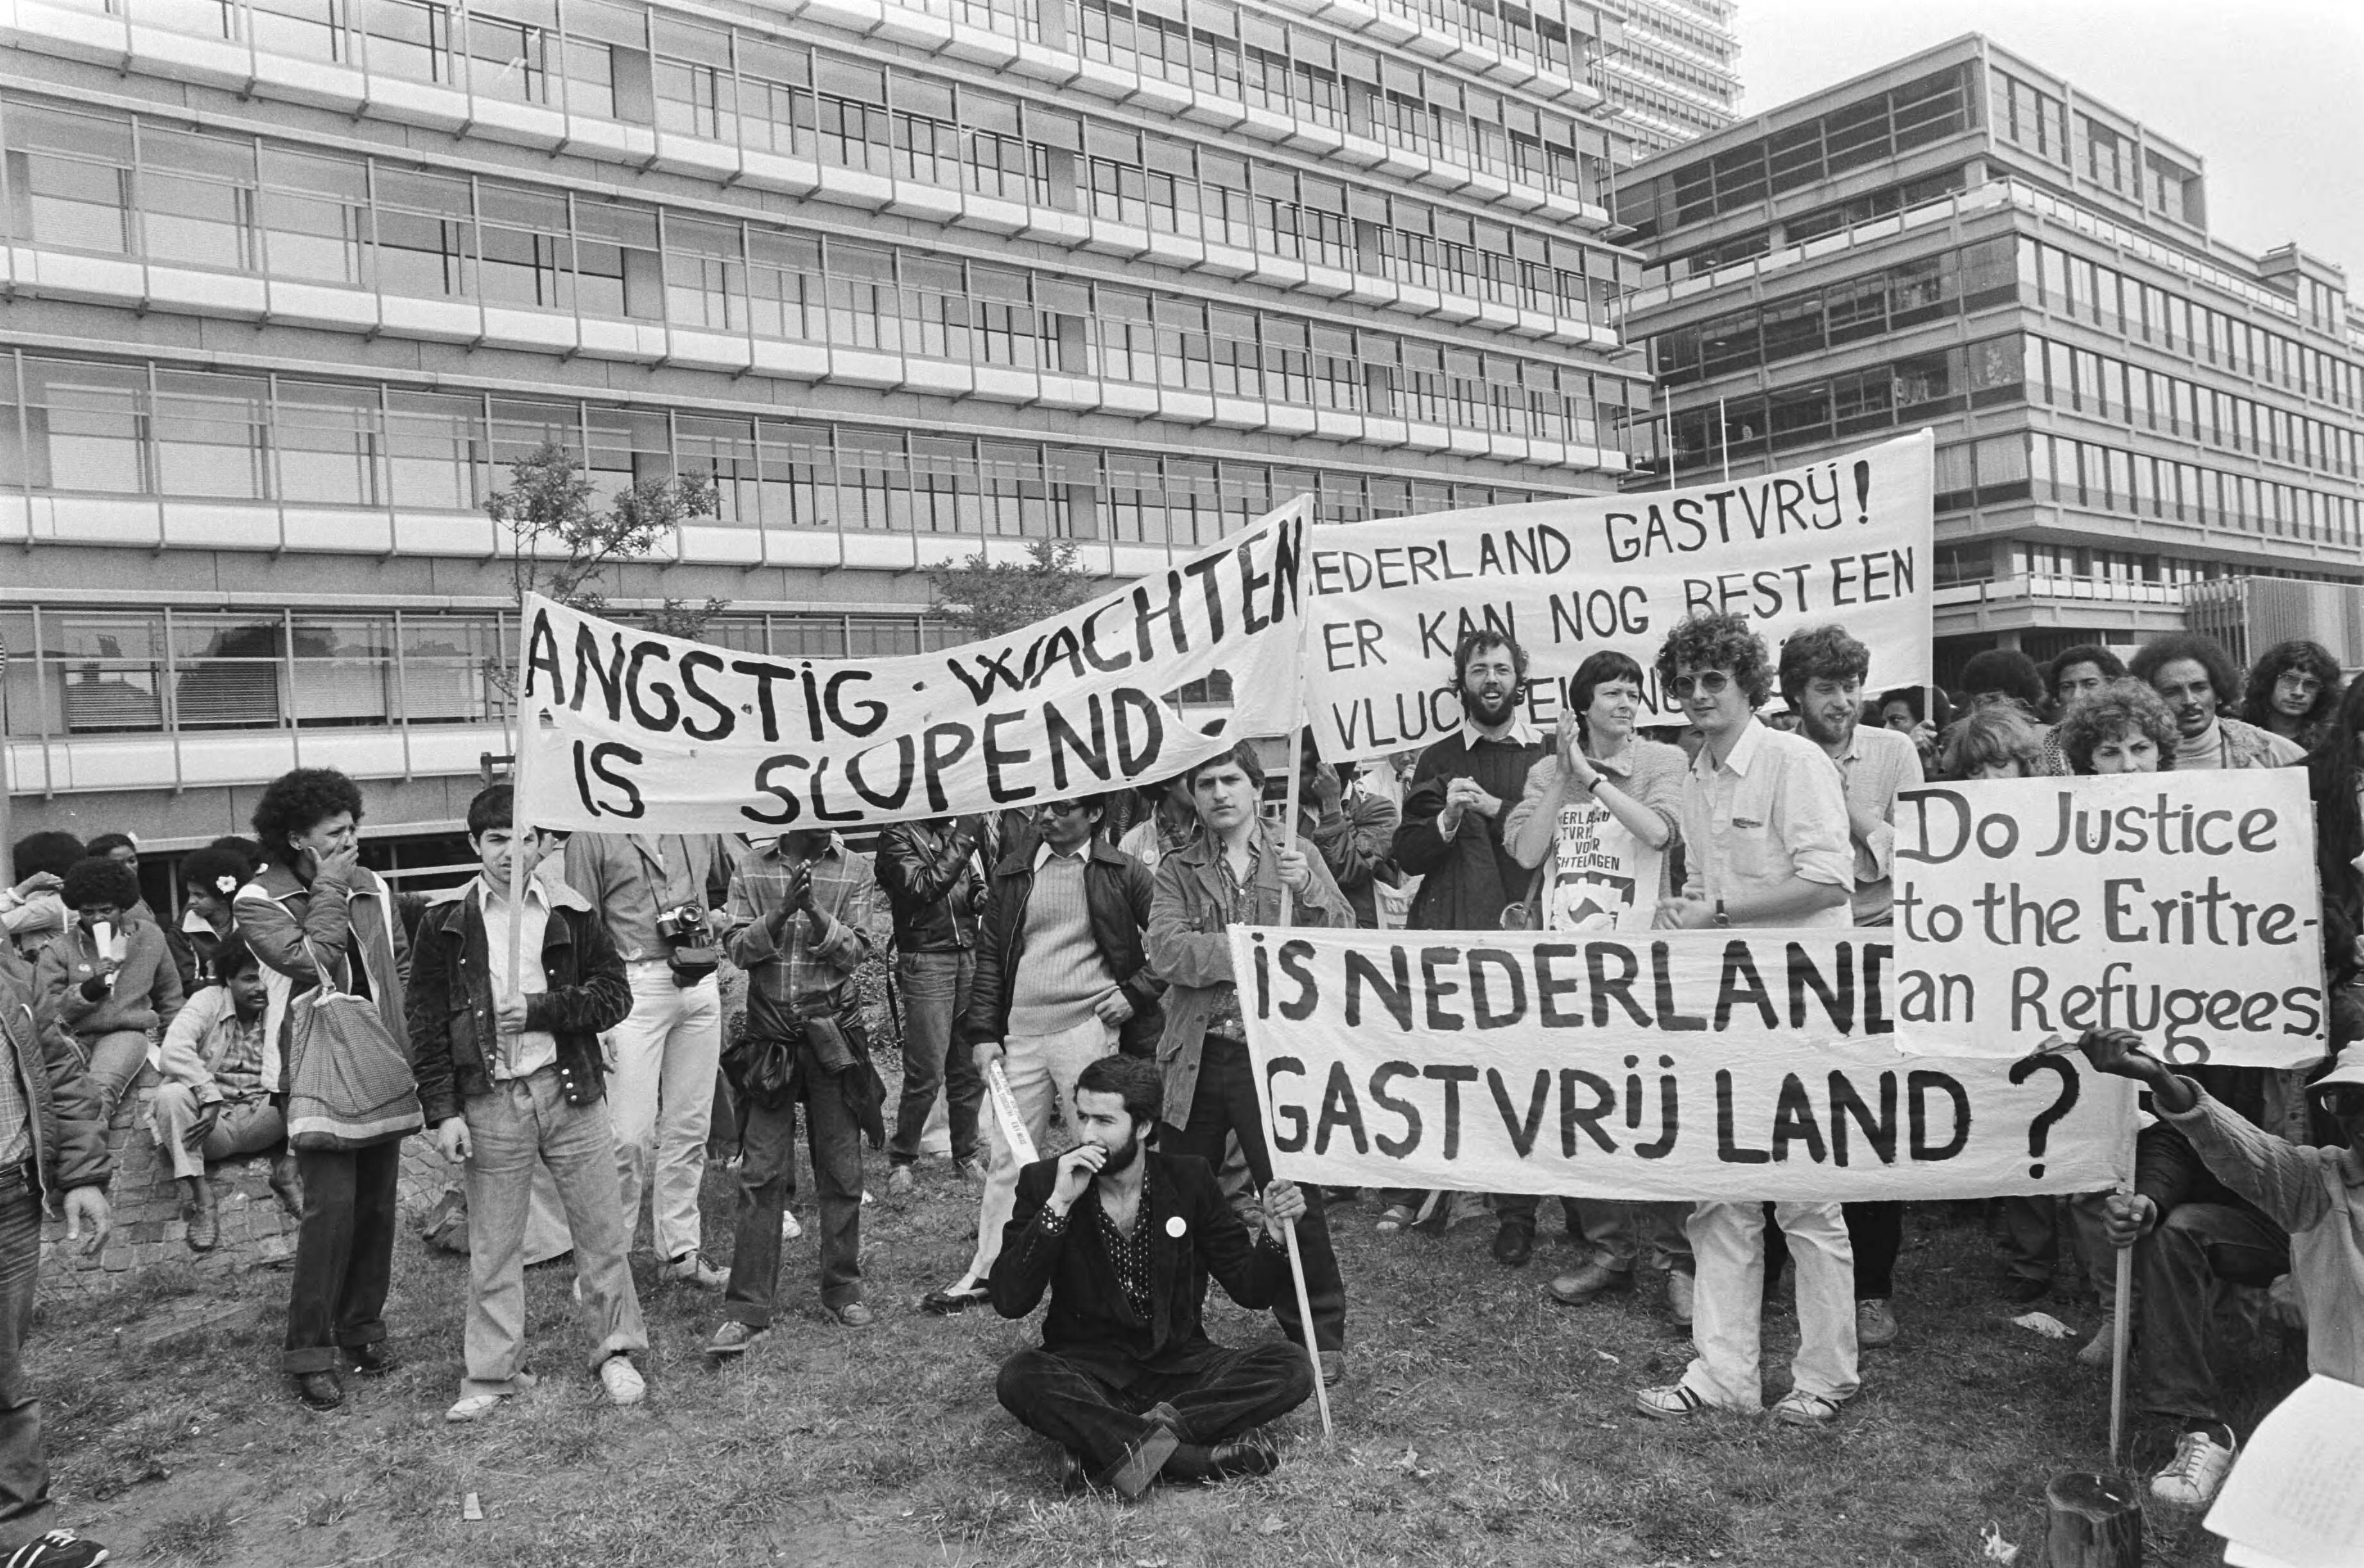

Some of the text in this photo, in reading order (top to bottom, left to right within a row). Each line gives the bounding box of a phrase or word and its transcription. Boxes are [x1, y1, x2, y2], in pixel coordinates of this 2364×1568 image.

[1309, 524, 1570, 595] EDERLAND
[947, 516, 1302, 706] WACHTEN
[1323, 546, 1914, 672] ER KAN NOG BEST EEN
[573, 740, 645, 819] IS
[1896, 788, 2277, 864] Do Justice
[1893, 876, 2318, 946] to the Eritre-
[1897, 962, 2325, 1065] an Refugees.
[1716, 1068, 1973, 1167] LAND
